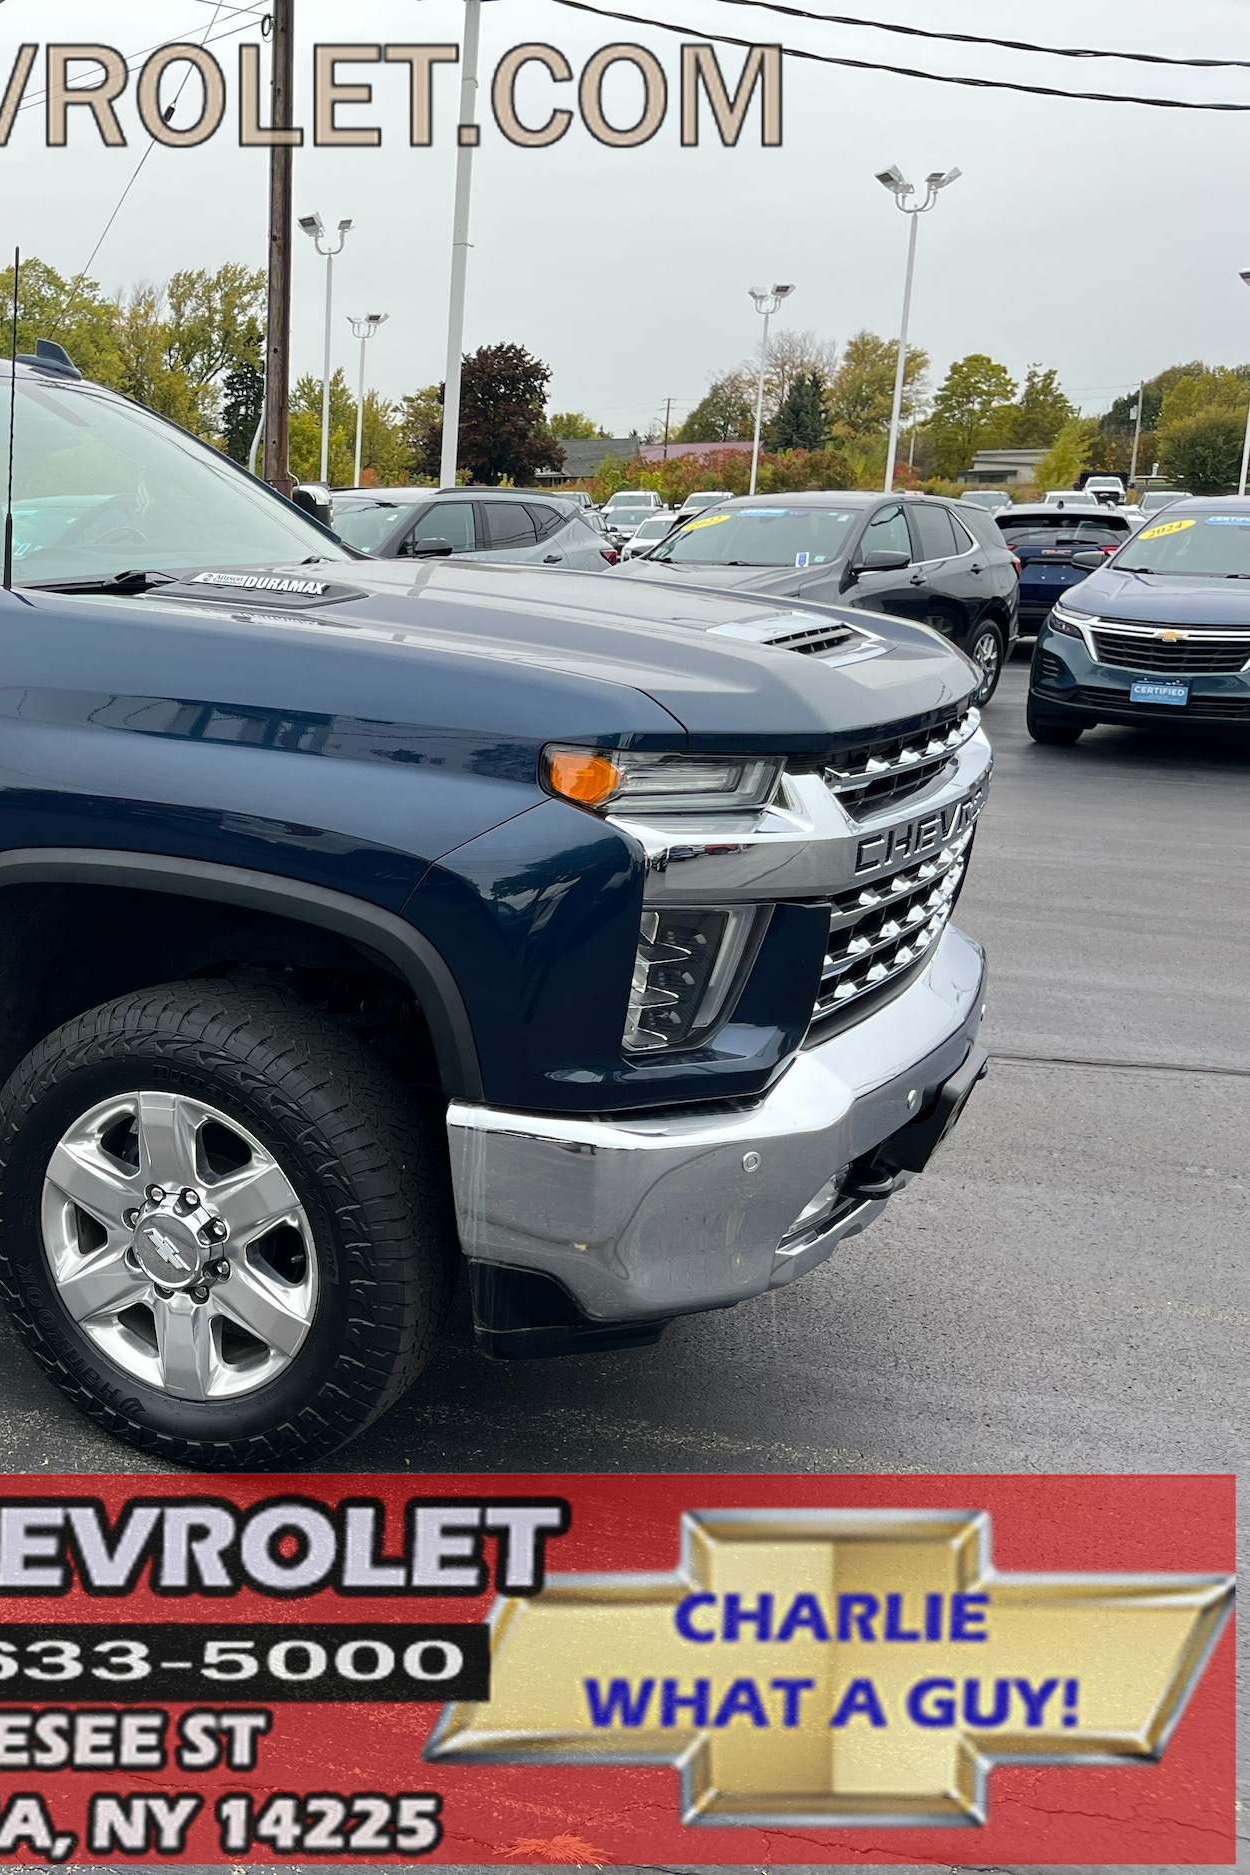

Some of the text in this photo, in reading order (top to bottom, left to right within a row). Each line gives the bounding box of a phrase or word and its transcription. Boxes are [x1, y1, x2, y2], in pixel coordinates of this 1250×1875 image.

[1147, 521, 1183, 538] 2024
[244, 576, 327, 595] DURAMAX
[1133, 685, 1185, 697] CERTIFIED
[854, 786, 987, 877] CHEVRO
